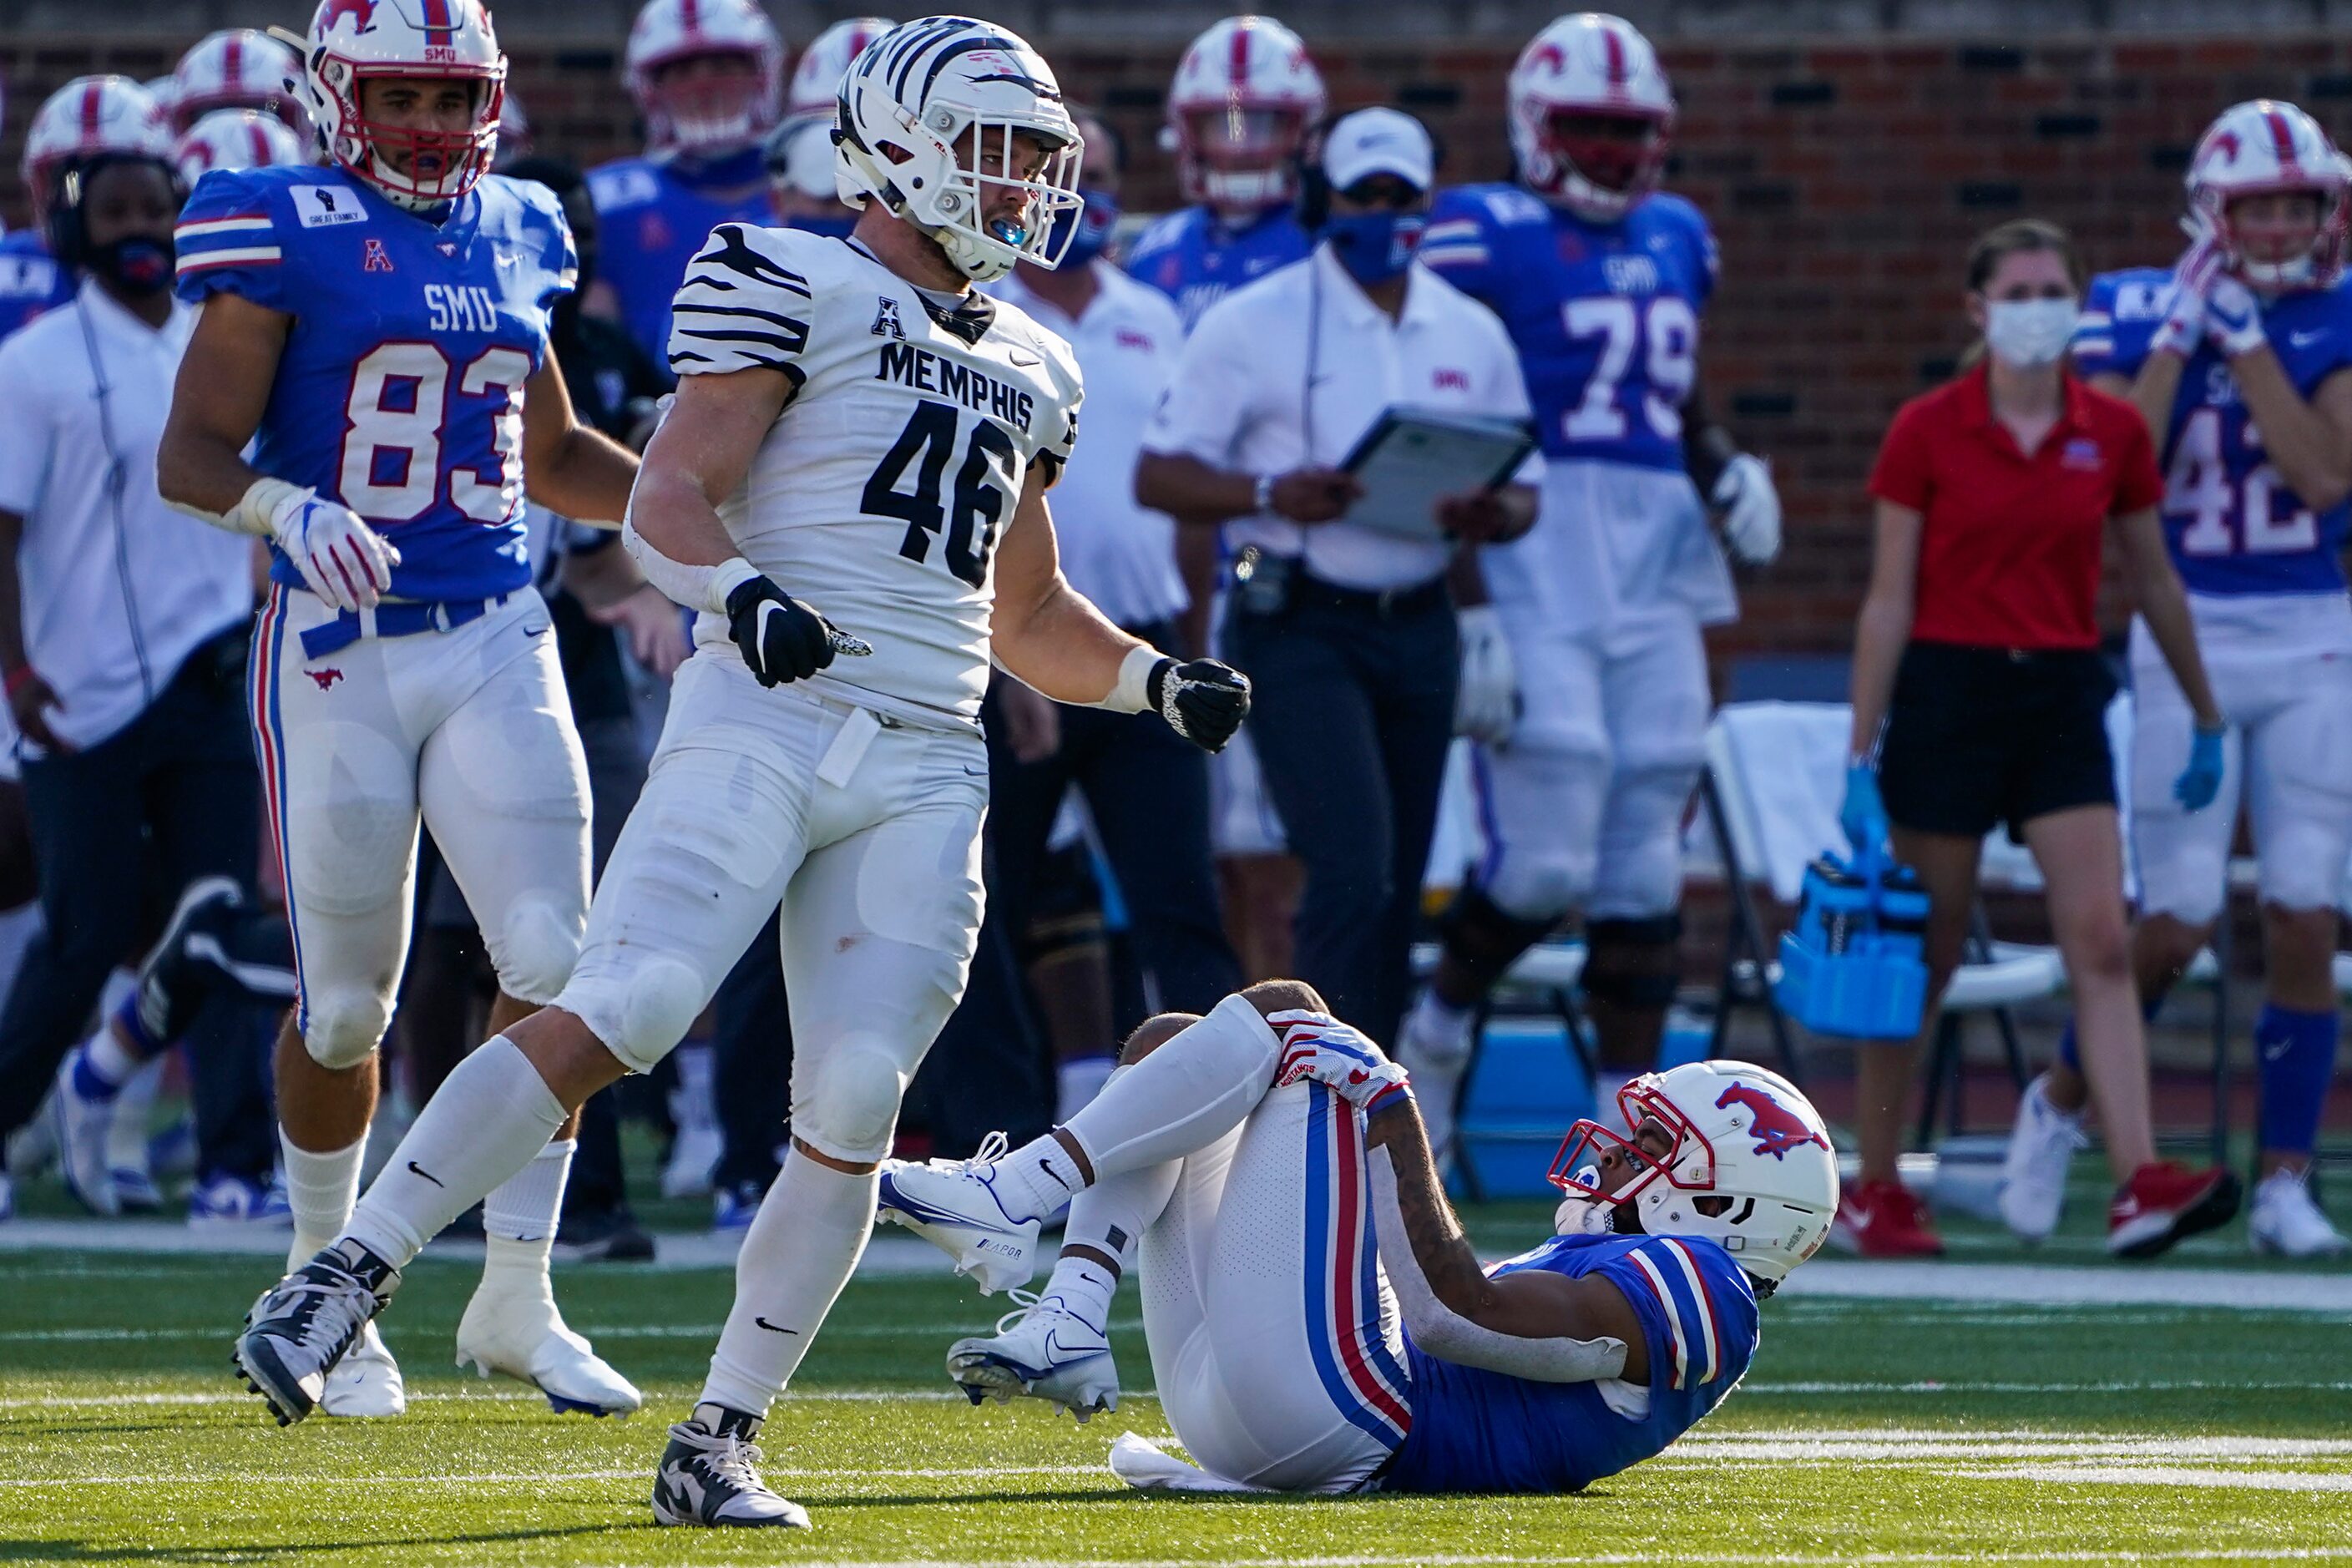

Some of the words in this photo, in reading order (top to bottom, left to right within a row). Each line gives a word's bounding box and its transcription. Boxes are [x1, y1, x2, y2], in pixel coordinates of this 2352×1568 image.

[424, 48, 456, 62] SMU
[309, 215, 331, 225] GREAT
[334, 212, 359, 223] FAMILY
[424, 284, 498, 332] SMU
[872, 296, 906, 341] A
[875, 342, 1034, 435] MEMPHIS
[1559, 296, 1698, 443] 79
[339, 338, 533, 526] 83
[860, 399, 1015, 589] 46
[2162, 407, 2320, 556] 42
[1280, 1063, 1316, 1087] MUSTANGS
[984, 1239, 1022, 1259] VAPOR
